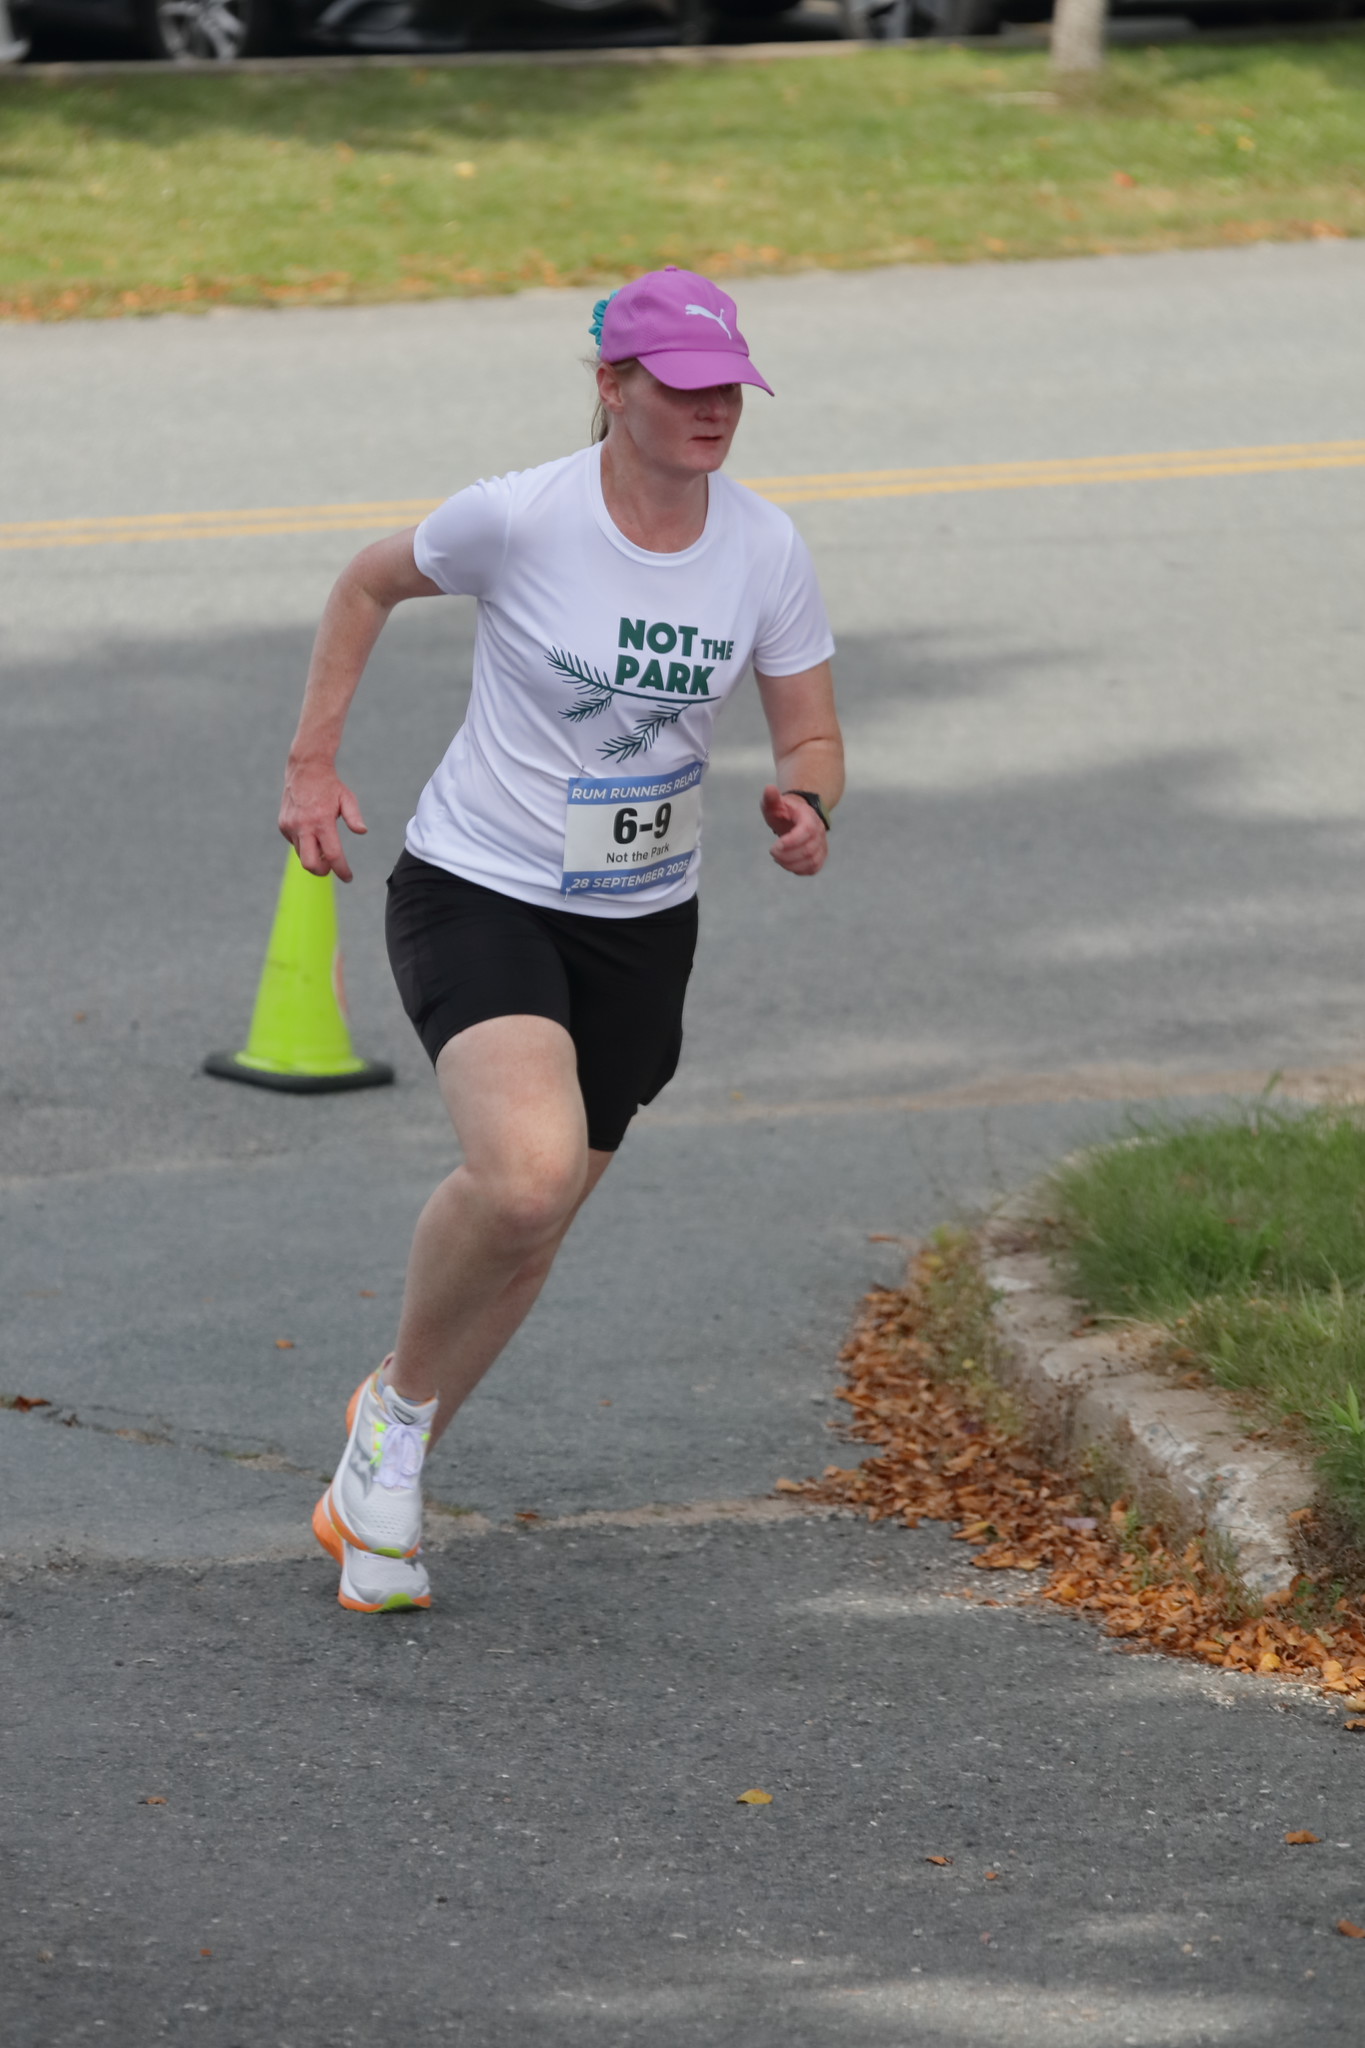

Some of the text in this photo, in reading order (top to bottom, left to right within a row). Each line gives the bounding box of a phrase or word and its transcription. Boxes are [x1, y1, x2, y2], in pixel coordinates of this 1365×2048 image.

[618, 617, 735, 661] NOT THE
[614, 654, 715, 696] PARK
[571, 769, 699, 799] RUM RUNNERS RELAY
[613, 802, 672, 845] 6-9
[606, 843, 669, 863] Not the Park
[571, 859, 689, 889] 28 SEPTEMBER 2025
